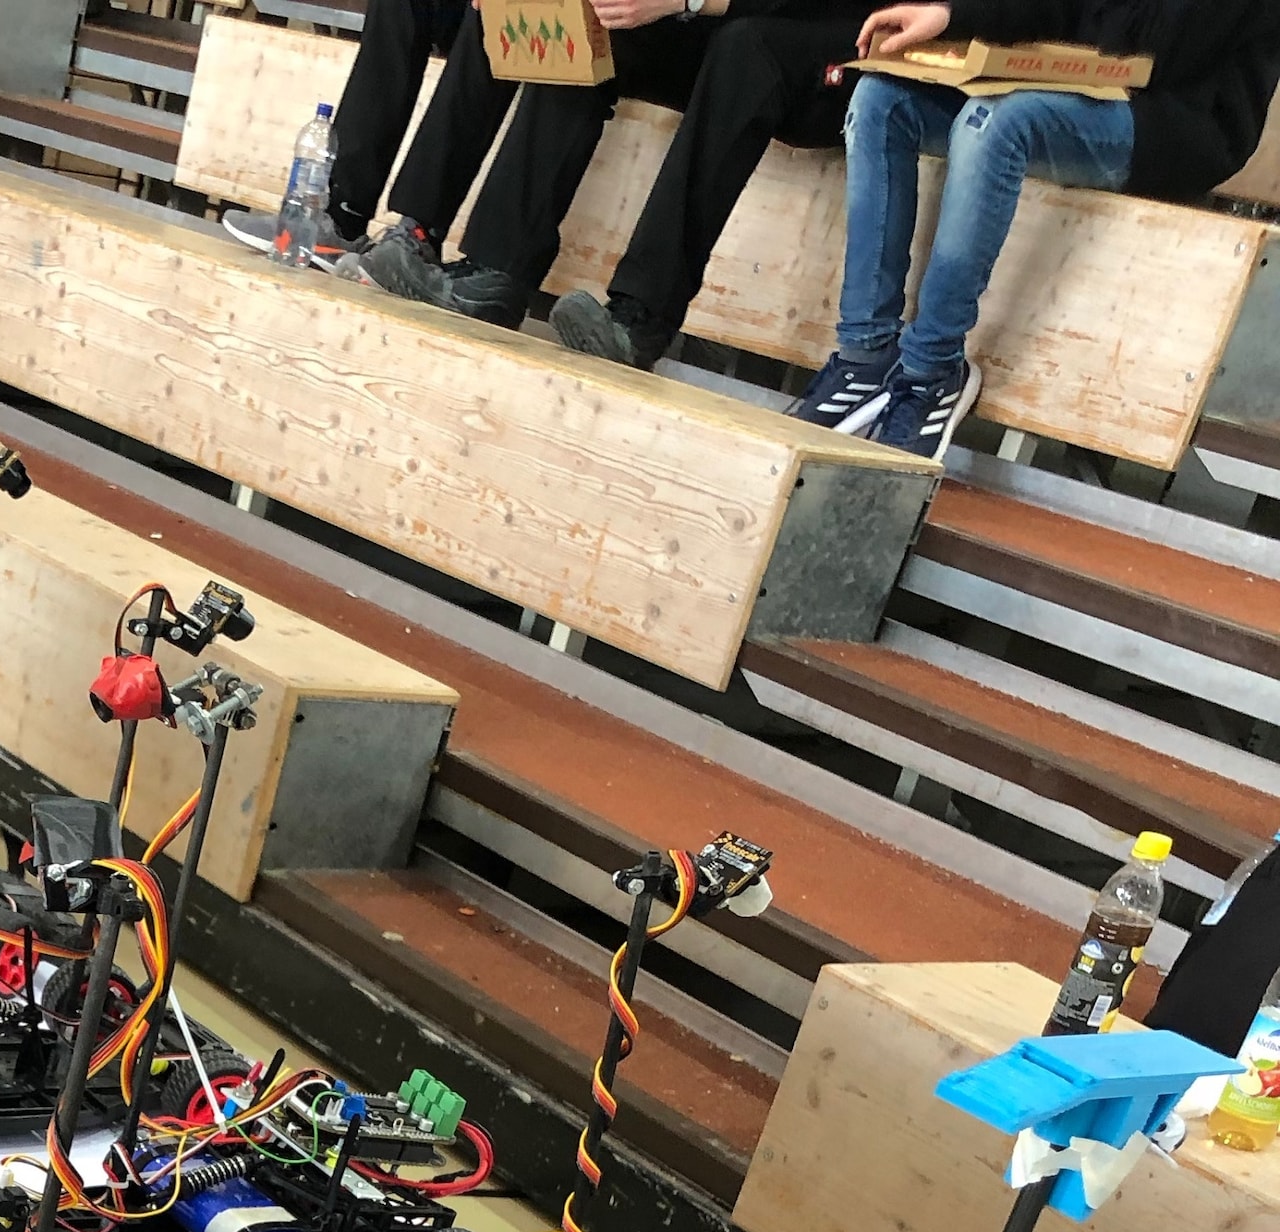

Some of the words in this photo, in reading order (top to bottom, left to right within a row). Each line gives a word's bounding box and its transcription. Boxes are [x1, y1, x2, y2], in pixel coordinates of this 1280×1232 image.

[1006, 56, 1042, 72] PIZZA
[1051, 60, 1088, 75] PIZZA
[1096, 64, 1132, 78] PIZZA
